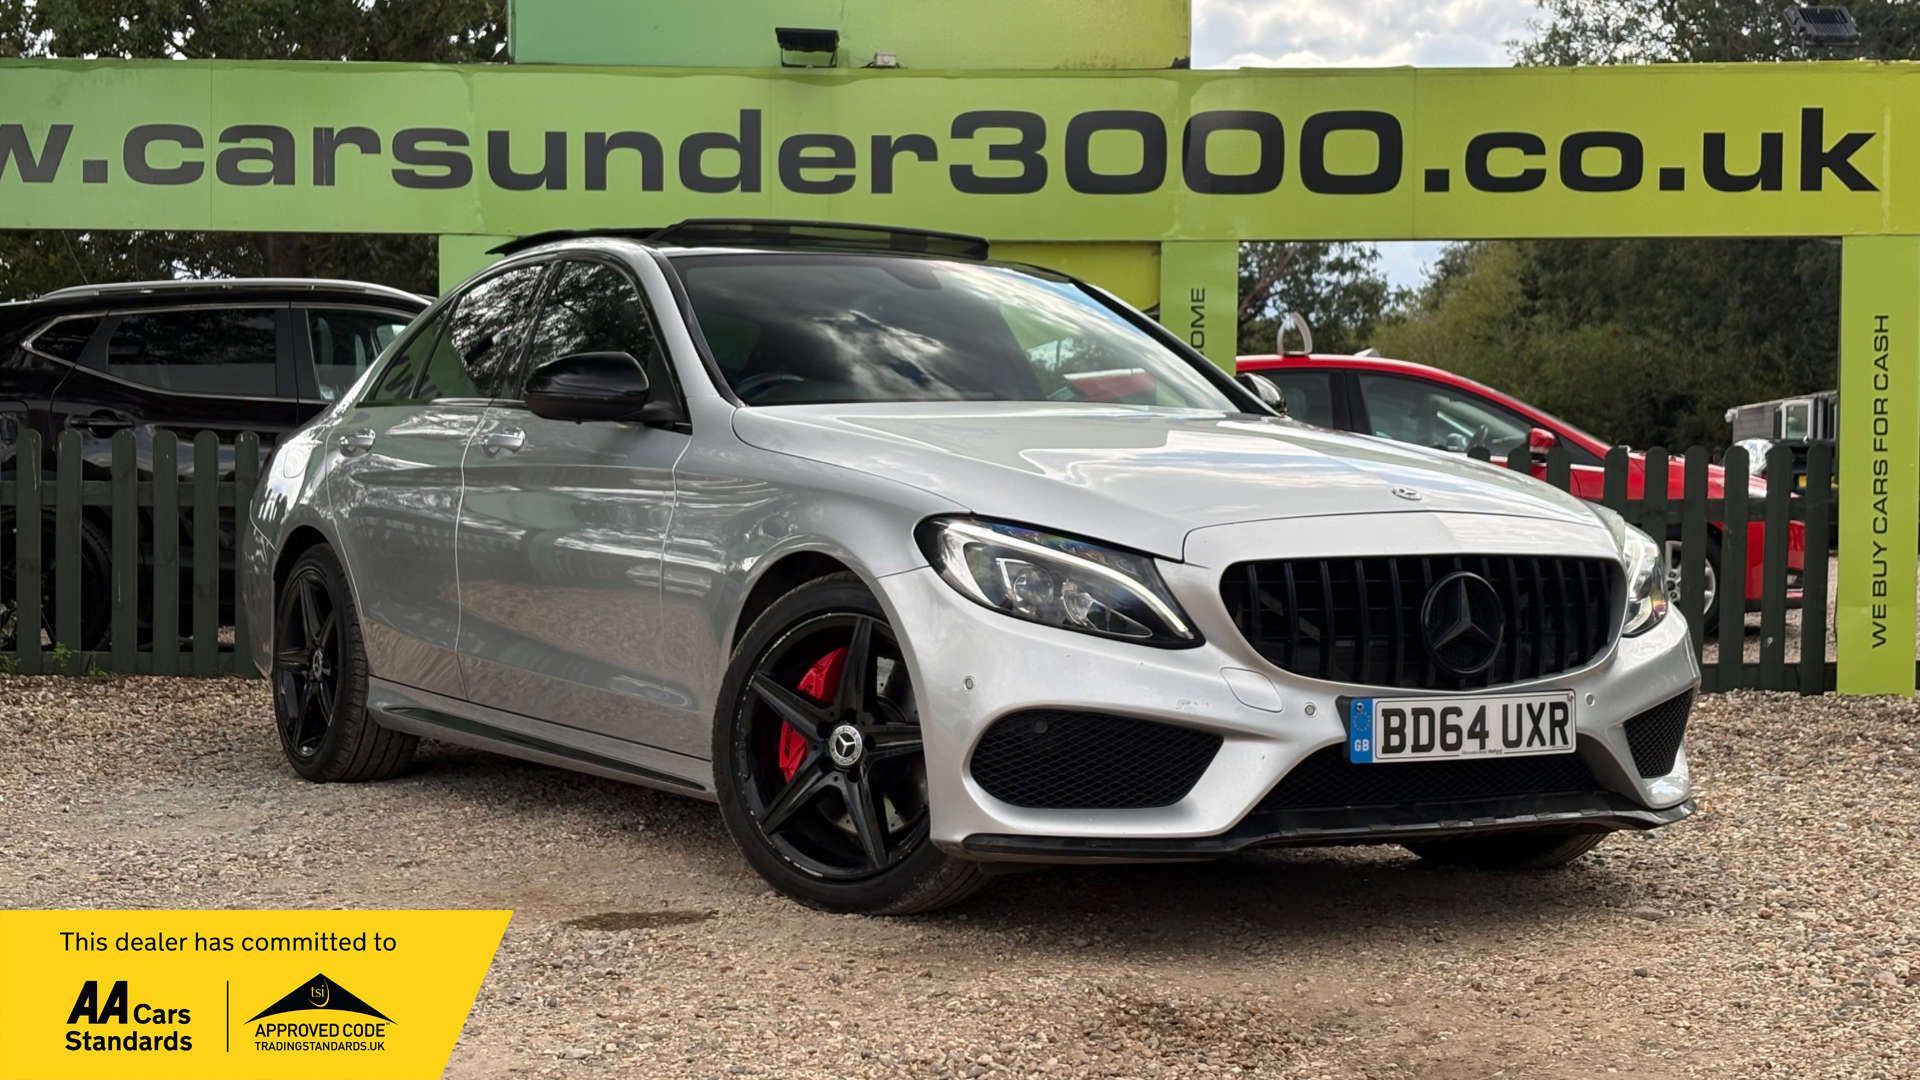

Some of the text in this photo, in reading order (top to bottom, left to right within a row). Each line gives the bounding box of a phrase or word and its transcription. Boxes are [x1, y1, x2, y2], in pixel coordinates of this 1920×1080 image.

[1190, 287, 1206, 355] OME
[1872, 315, 1889, 649] WE BUY CARS FOR CASH
[1354, 739, 1370, 752] GB
[1381, 701, 1570, 754] BD64 UXR
